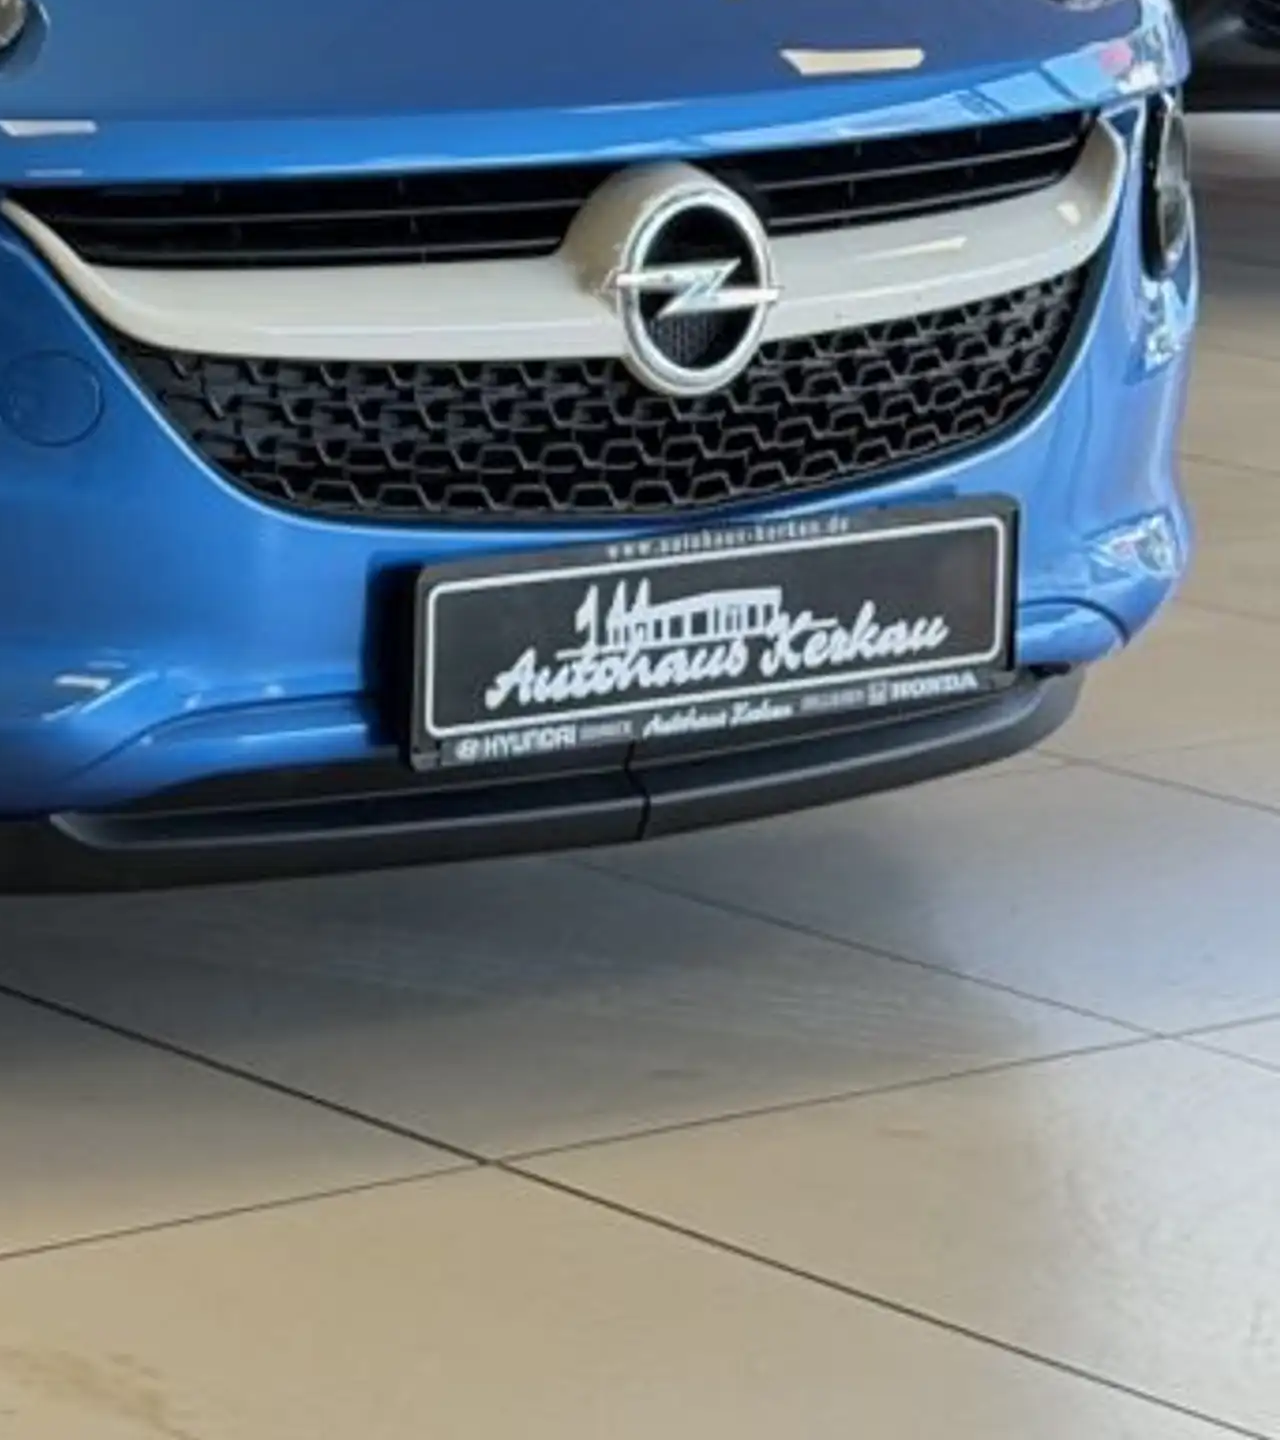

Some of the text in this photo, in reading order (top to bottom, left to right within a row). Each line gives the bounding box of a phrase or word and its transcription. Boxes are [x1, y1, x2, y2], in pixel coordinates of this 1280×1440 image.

[484, 636, 748, 710] Autohaus
[891, 669, 979, 702] HONDA
[483, 722, 577, 759] HYUNDAI
